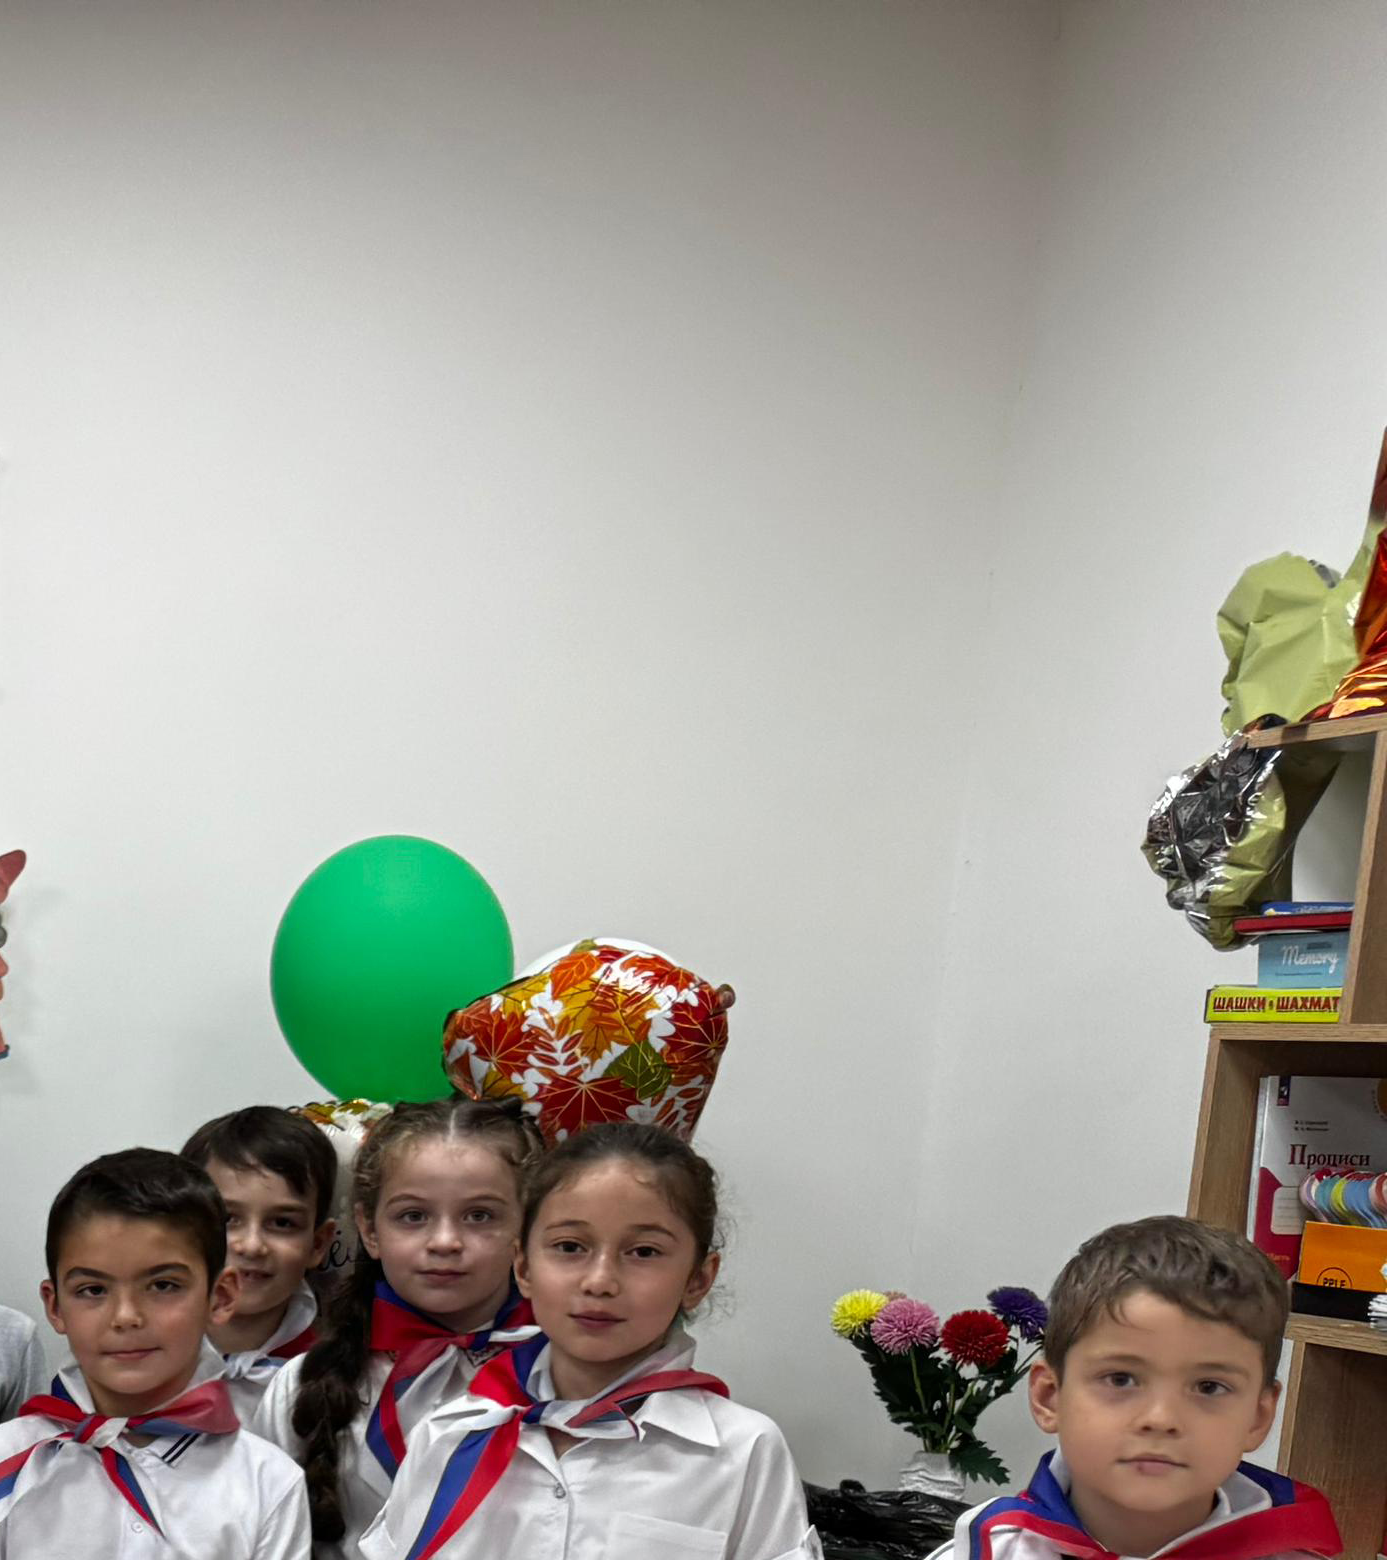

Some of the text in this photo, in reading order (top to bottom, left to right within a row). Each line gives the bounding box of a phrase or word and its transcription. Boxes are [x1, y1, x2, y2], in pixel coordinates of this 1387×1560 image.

[1281, 944, 1340, 975] Memory
[1213, 996, 1341, 1013] ШАШКИ ШАХМАТ
